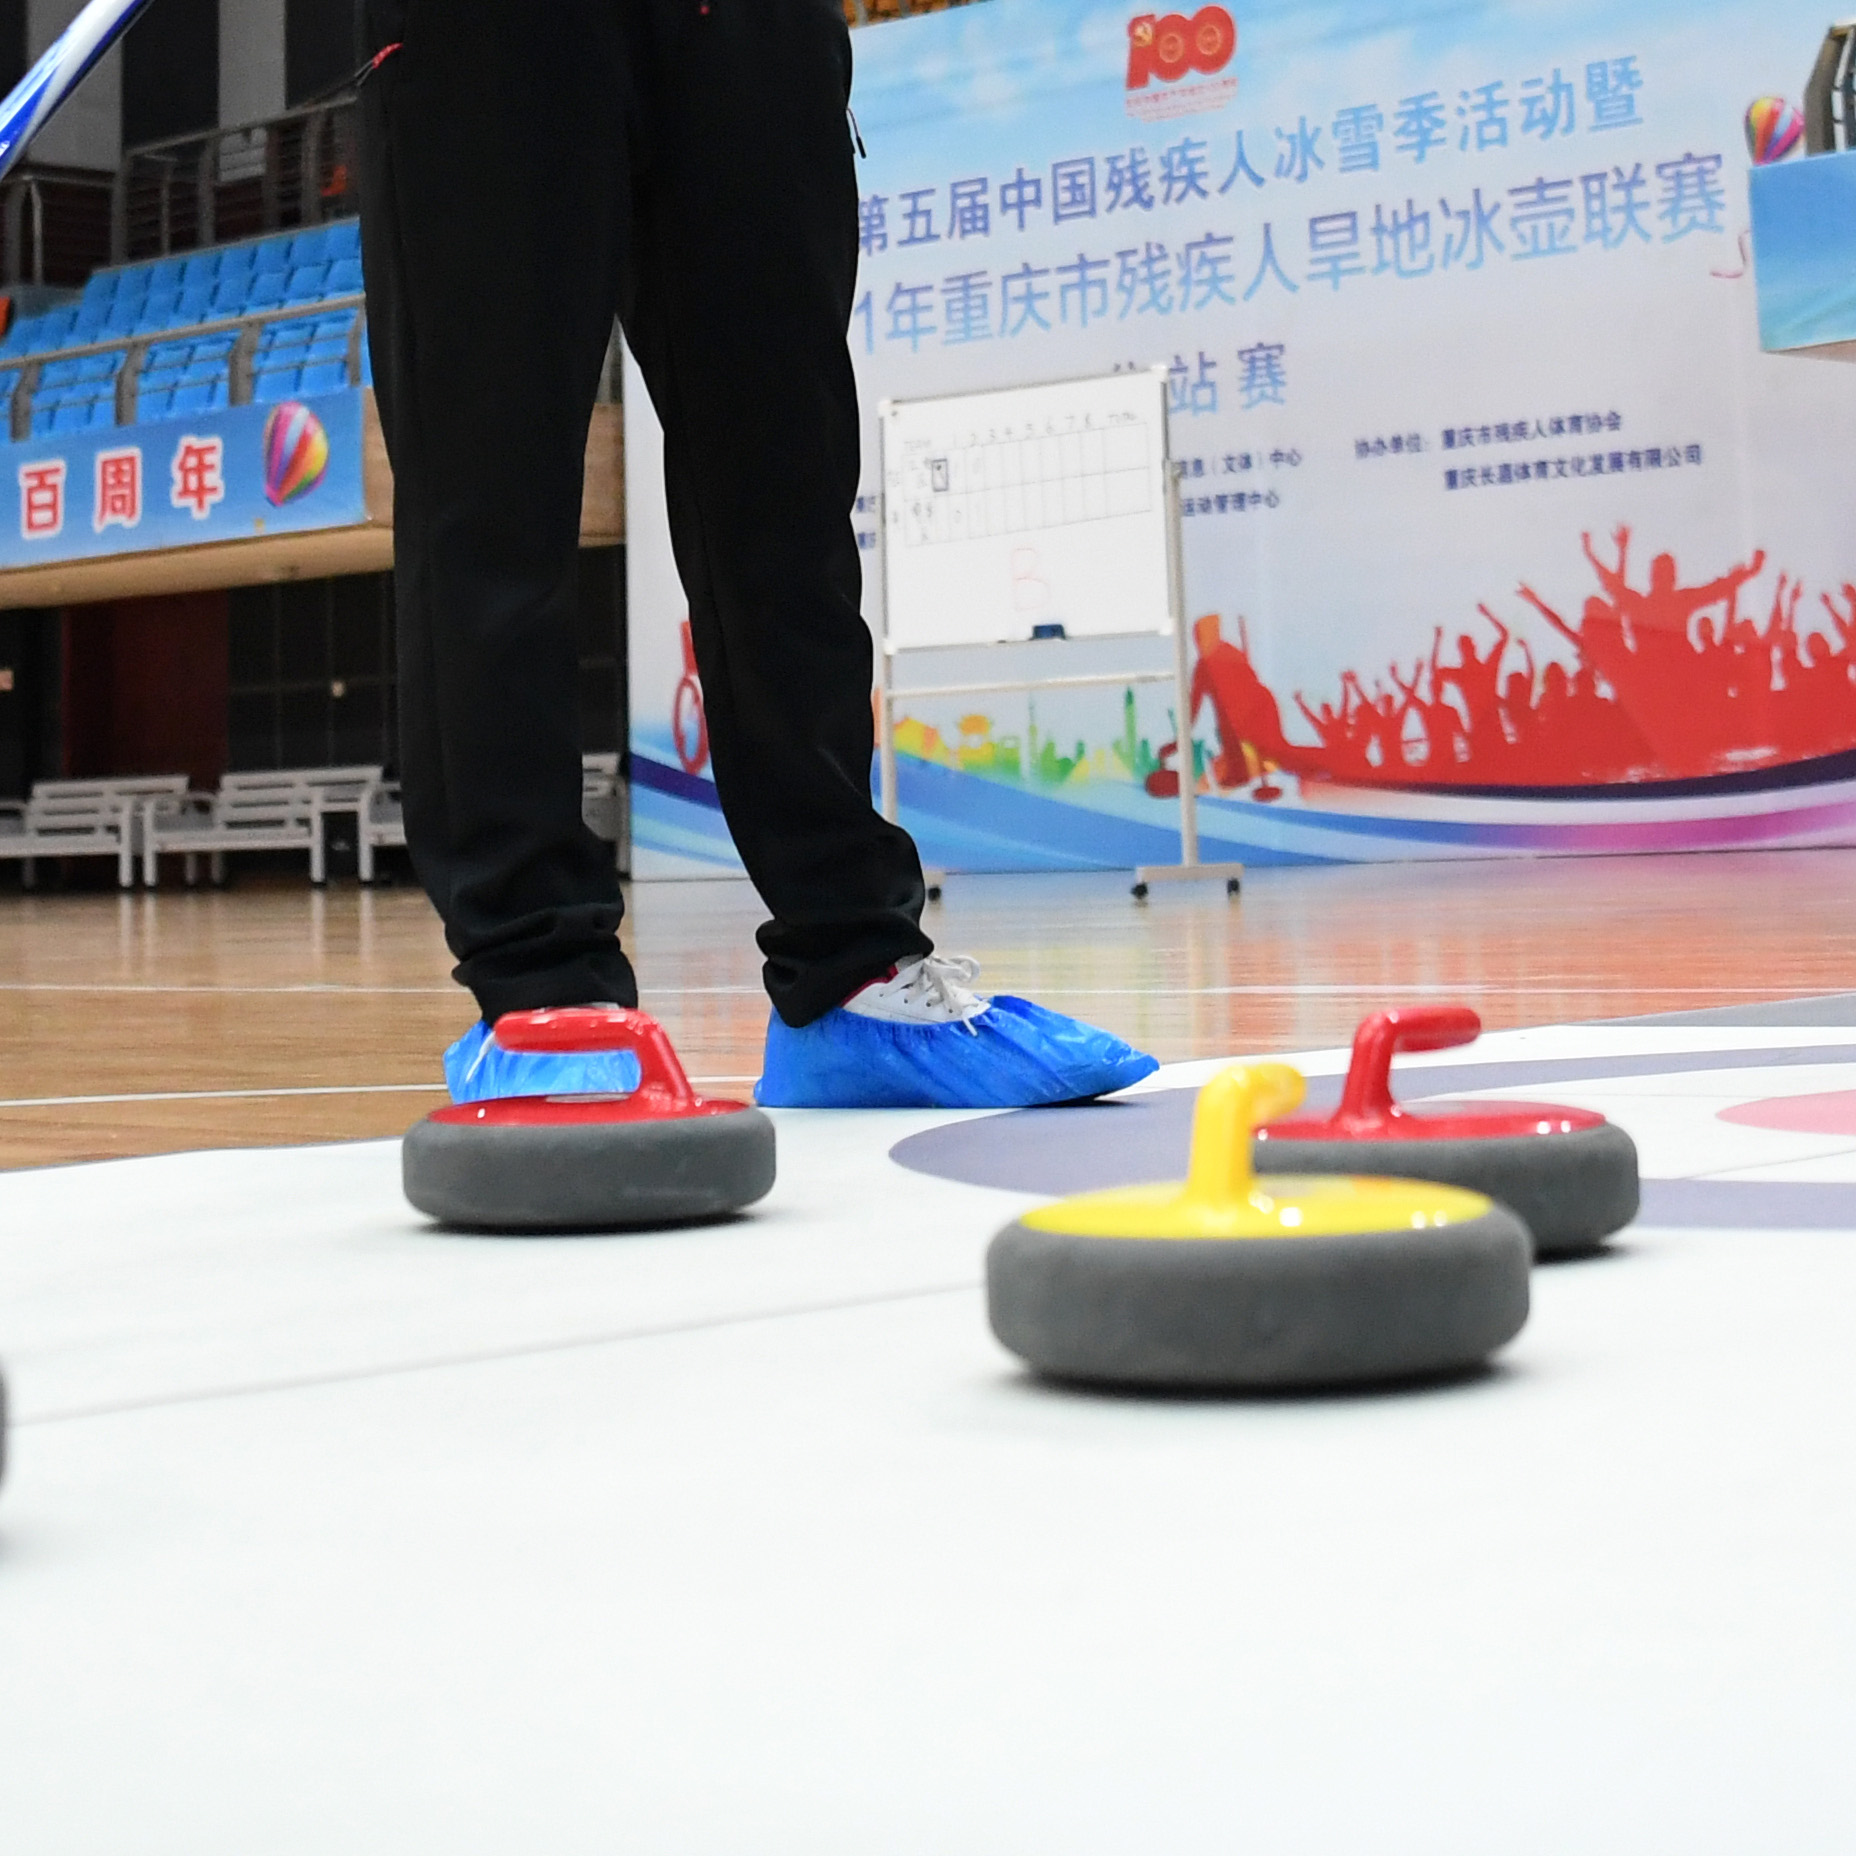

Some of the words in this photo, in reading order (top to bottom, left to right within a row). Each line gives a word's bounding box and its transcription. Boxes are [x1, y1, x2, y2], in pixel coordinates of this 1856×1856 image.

[1125, 5, 1237, 91] 100
[858, 55, 1645, 256] 第五届中国残疾人冰雪季活动暨
[1112, 342, 1287, 416] 站赛
